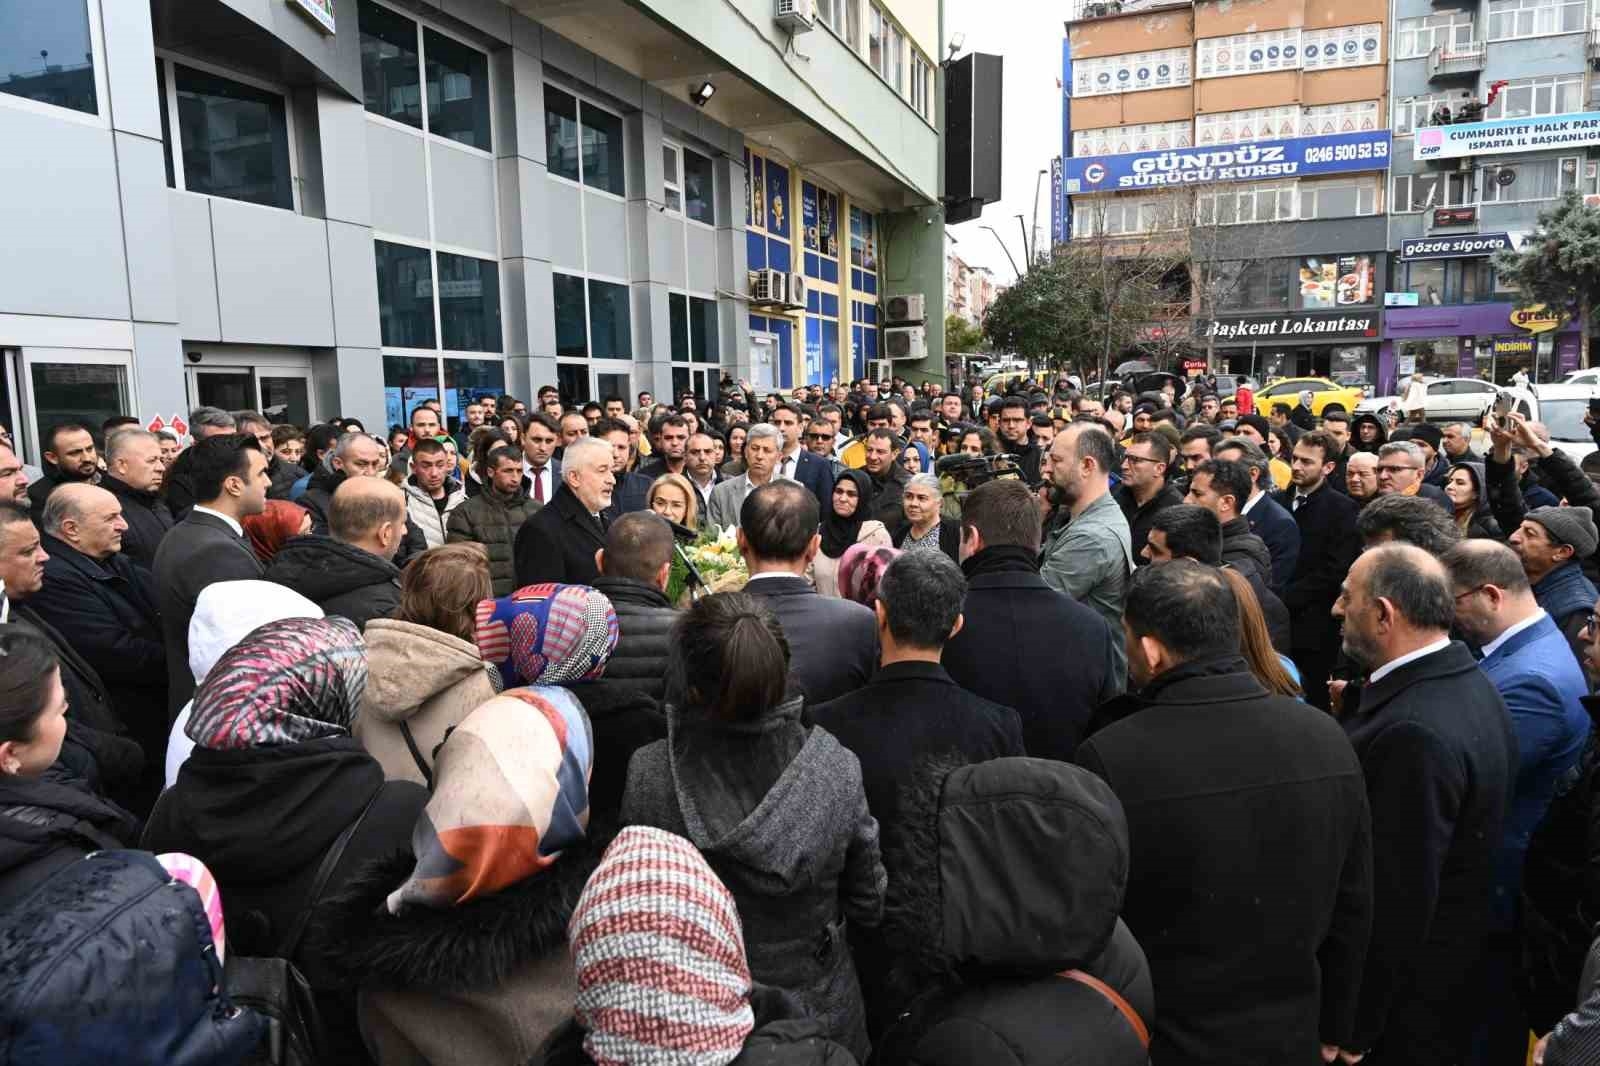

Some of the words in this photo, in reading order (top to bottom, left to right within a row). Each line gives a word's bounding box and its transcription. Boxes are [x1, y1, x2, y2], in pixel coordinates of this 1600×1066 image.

[1534, 122, 1569, 133] HALK
[1573, 119, 1600, 130] PAR
[1305, 146, 1334, 164] 0246
[1335, 143, 1357, 161] 500
[1358, 142, 1372, 159] 52
[1374, 141, 1388, 157] 53
[1420, 146, 1441, 155] CHP
[1468, 139, 1514, 151] ISPARTA
[1132, 145, 1285, 173] GÜNDÜZ
[1119, 167, 1216, 187] SÜRÜCÜ
[1219, 161, 1298, 179] KURSU
[1406, 242, 1450, 256] gözde
[1452, 239, 1505, 252] sigorta
[1204, 319, 1278, 339] Başkent
[1280, 317, 1370, 335] Lokantası
